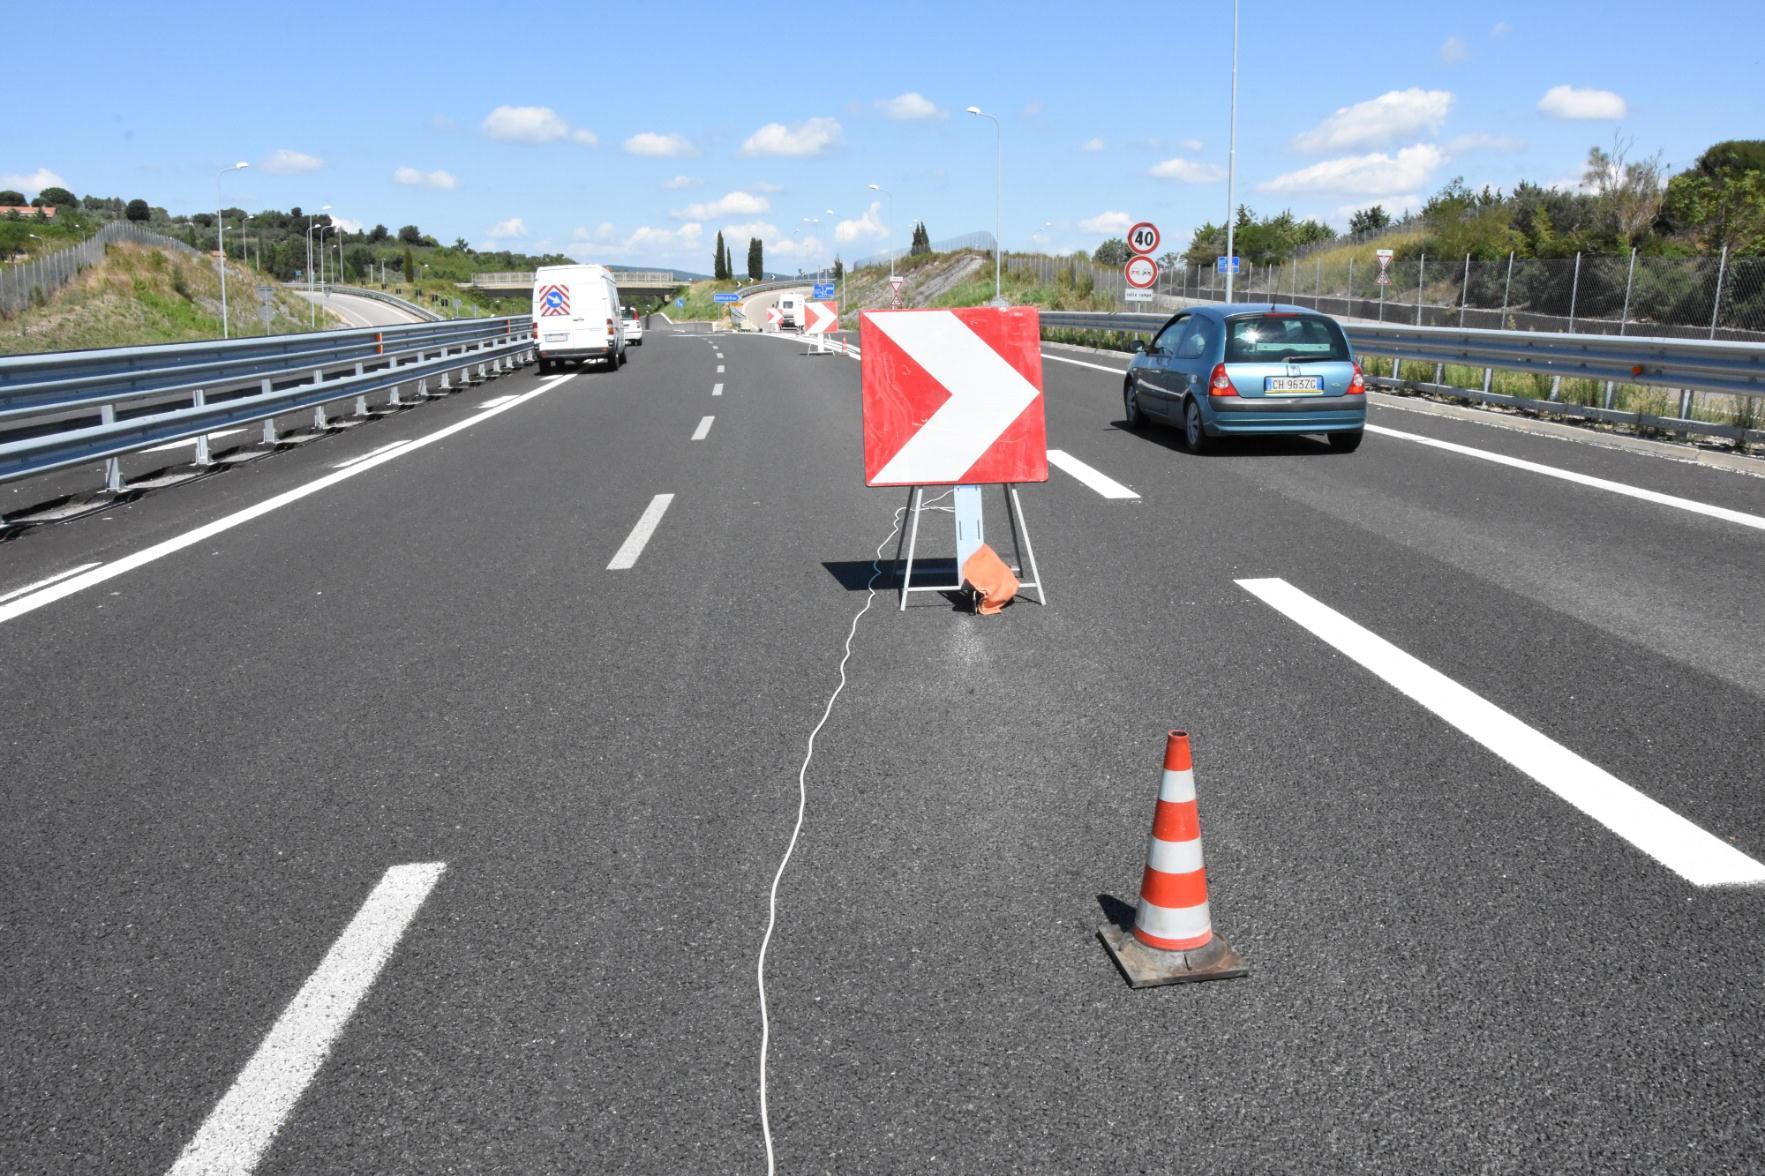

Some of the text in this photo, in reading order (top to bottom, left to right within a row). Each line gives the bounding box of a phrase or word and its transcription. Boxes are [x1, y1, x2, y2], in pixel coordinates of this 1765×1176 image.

[1135, 231, 1154, 246] 40
[1272, 379, 1316, 390] CH 963ZG
